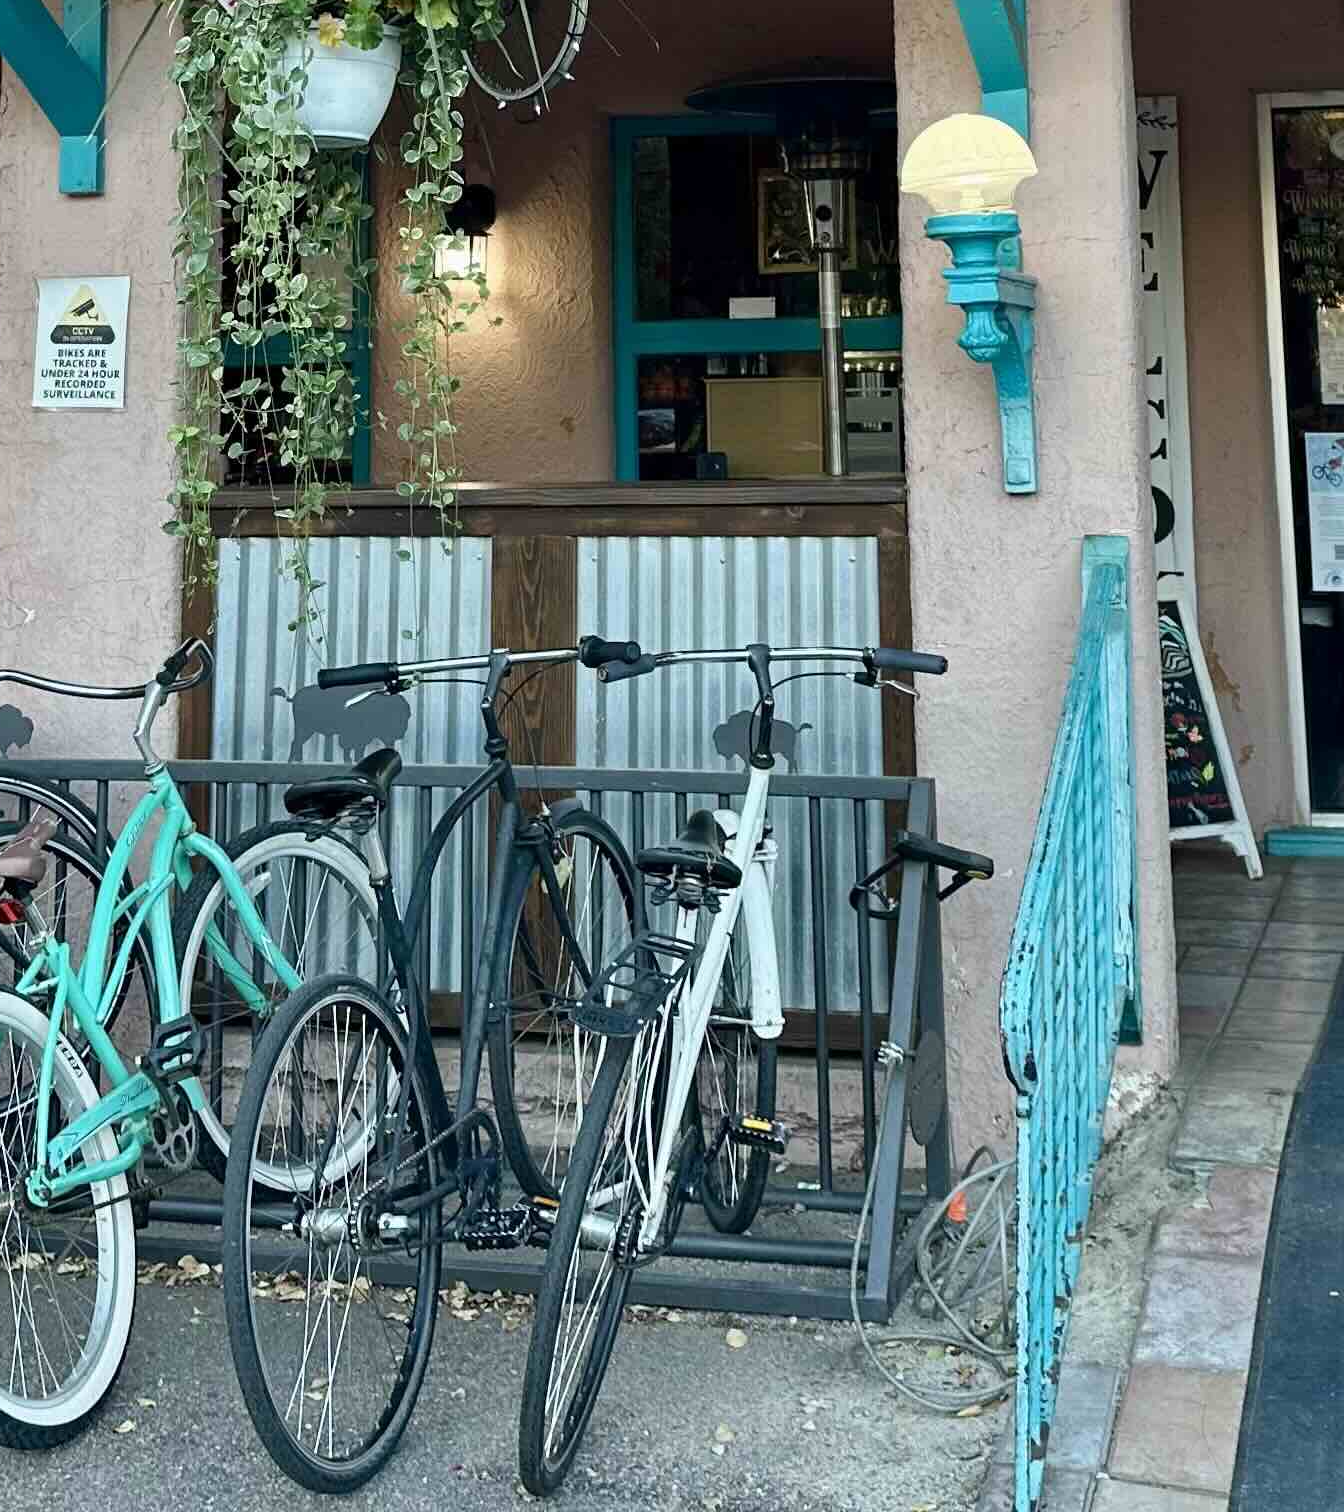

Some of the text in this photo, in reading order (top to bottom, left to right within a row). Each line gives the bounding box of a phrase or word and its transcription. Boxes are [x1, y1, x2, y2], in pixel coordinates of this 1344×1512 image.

[72, 327, 95, 335] CCTV
[57, 349, 107, 357] BIKES ARE
[53, 359, 107, 368] TRACKED &
[41, 369, 120, 378] UNDER 24 HOUR
[54, 379, 106, 388] RECORDED
[43, 390, 117, 399] SURVEILLANCE
